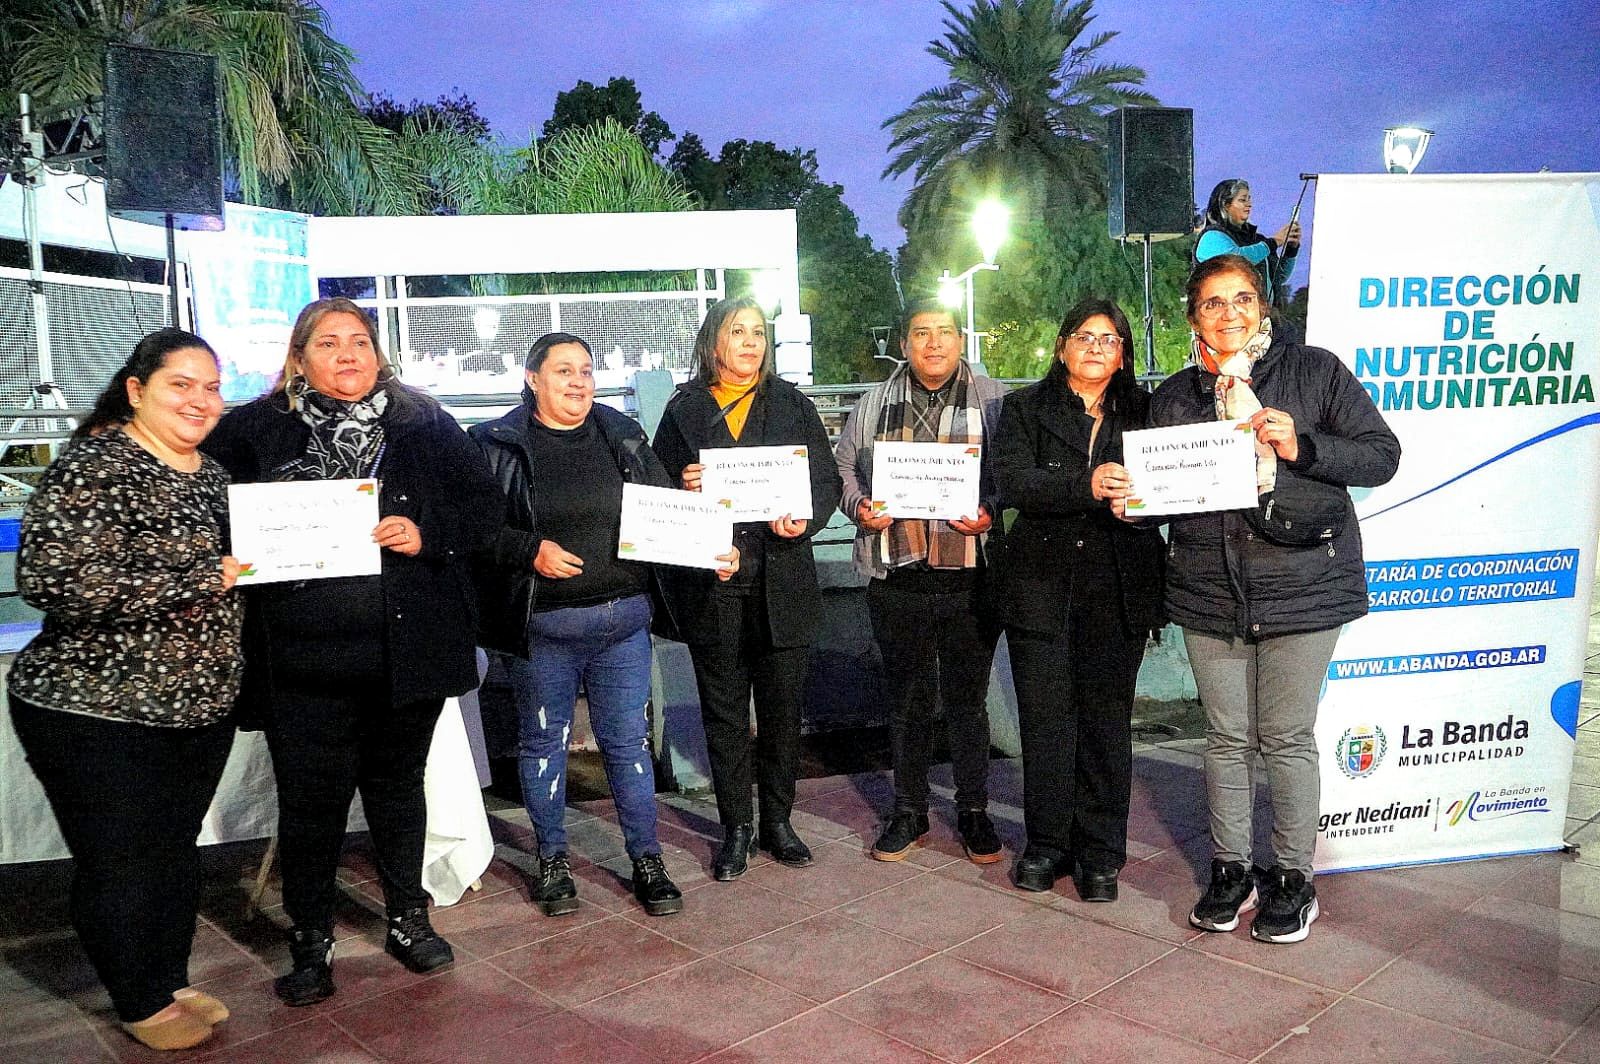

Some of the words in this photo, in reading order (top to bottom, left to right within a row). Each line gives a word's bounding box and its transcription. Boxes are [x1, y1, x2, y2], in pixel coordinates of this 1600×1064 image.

[1359, 265, 1581, 308] DIRECCIÓN
[1443, 310, 1496, 341] DE
[1355, 333, 1575, 378] NUTRICIÓN
[1421, 564, 1444, 579] DE
[1447, 552, 1574, 578] COORDINACIÓN
[1458, 580, 1557, 600] TERRITORIAL
[1337, 648, 1540, 676] WWW.LABANDA.GOB.AR
[1402, 724, 1433, 749] La
[1443, 714, 1529, 745] Banda
[1399, 746, 1524, 767] MUNICIPALIDAD
[1485, 790, 1497, 798] La
[1500, 786, 1531, 796] Banda
[1318, 812, 1352, 832] ger
[1355, 799, 1431, 824] Nediani
[1326, 824, 1395, 839] INTENDENTE
